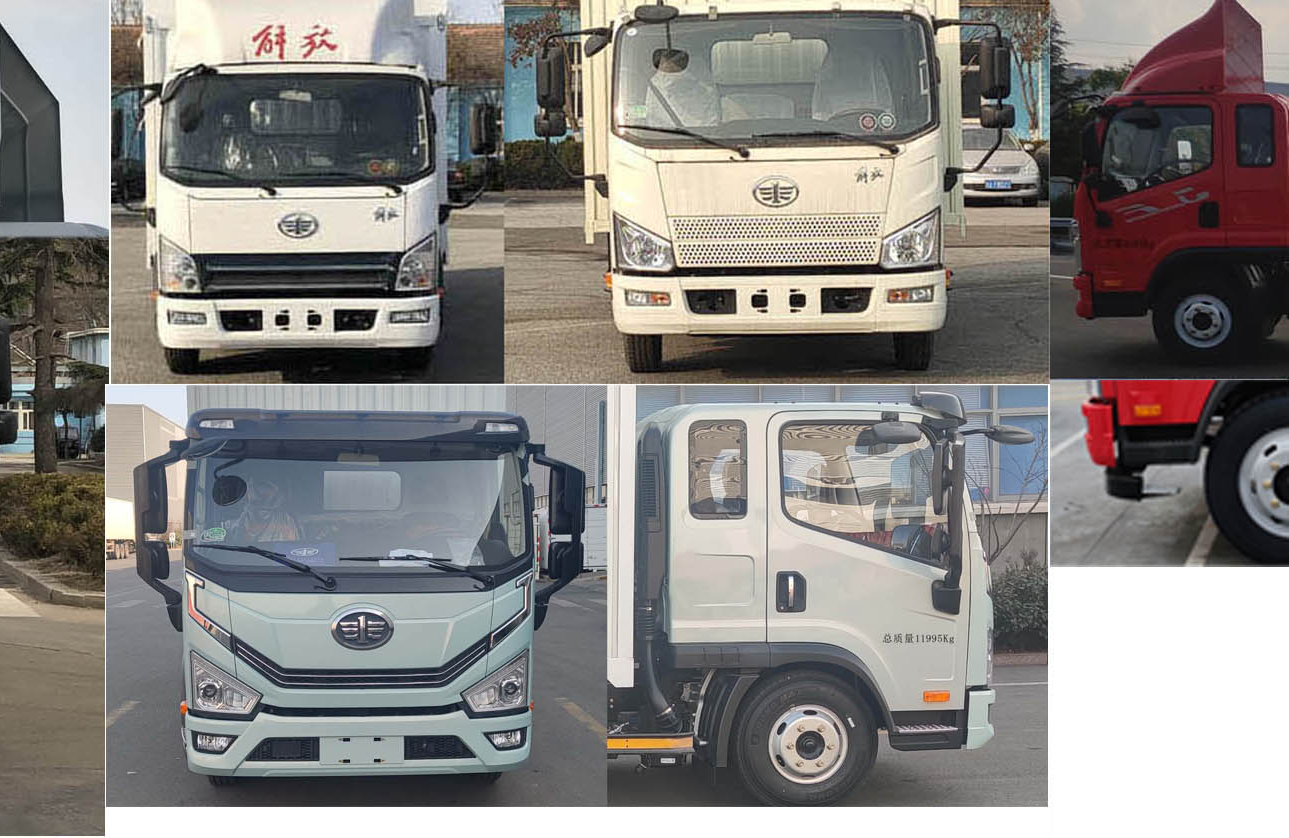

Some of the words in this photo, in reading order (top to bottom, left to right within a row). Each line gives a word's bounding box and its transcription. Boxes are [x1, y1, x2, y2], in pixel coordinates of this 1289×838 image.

[252, 24, 338, 60] 解放
[882, 633, 955, 644] 总质量11995Kg
